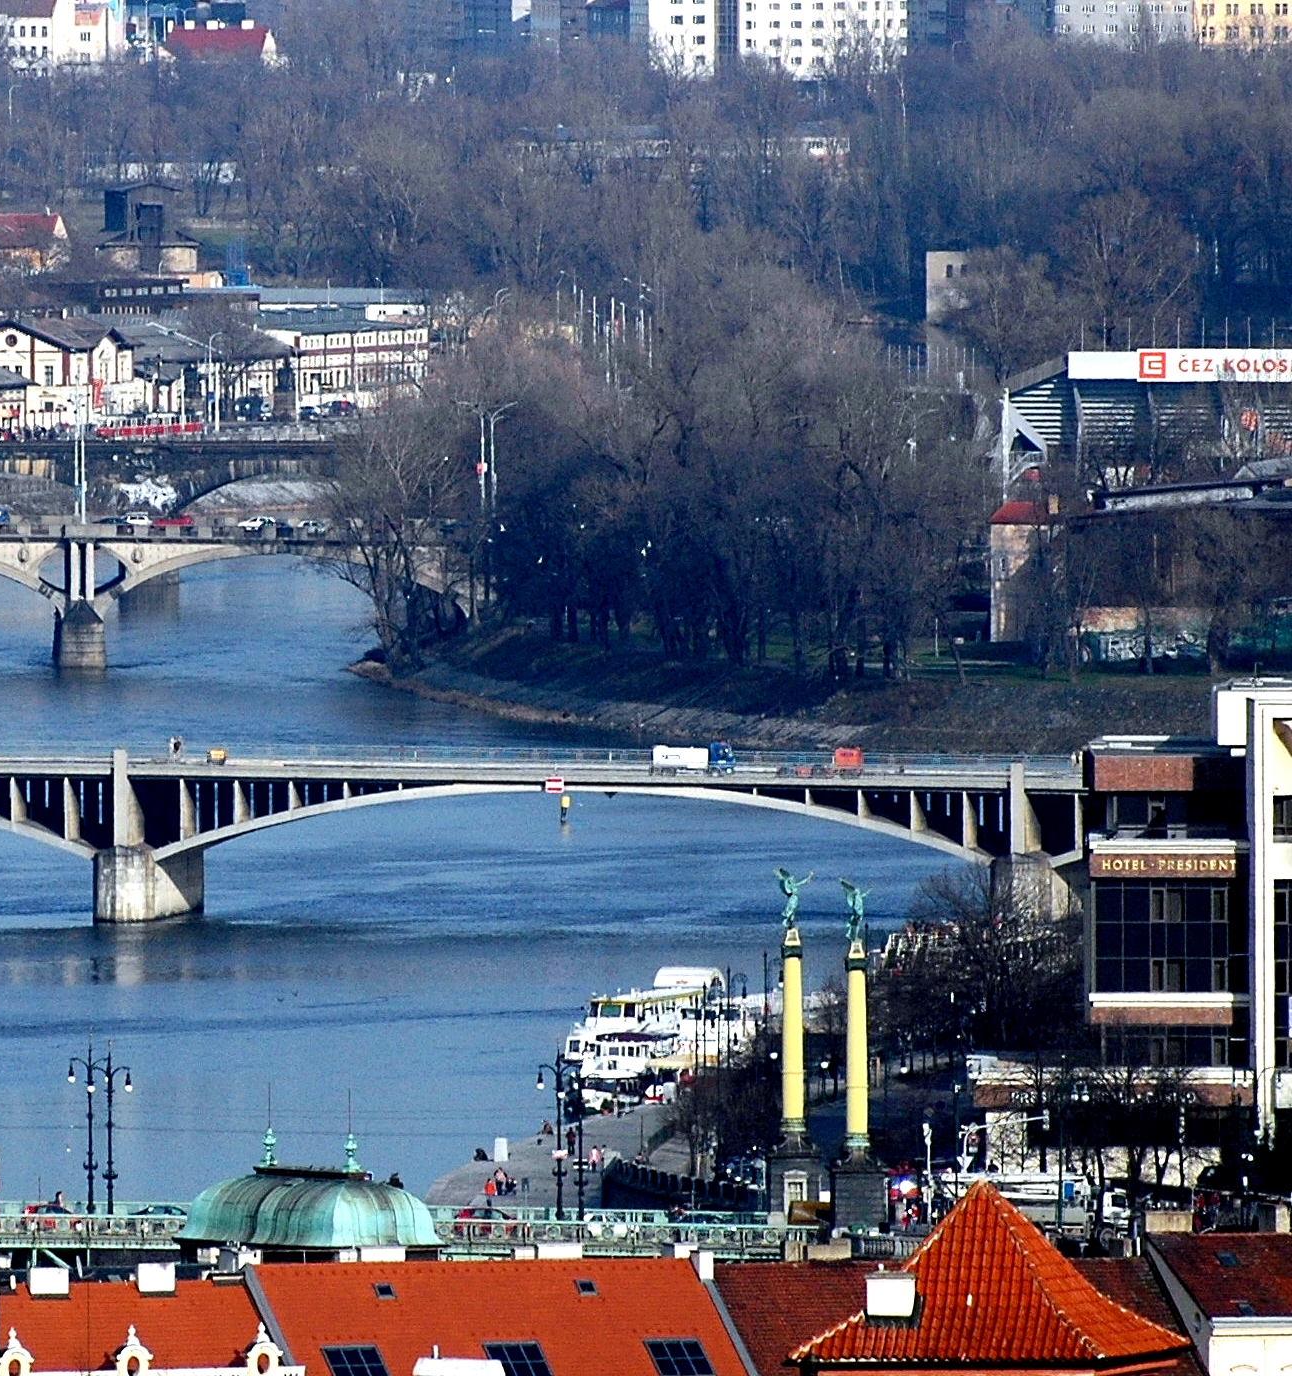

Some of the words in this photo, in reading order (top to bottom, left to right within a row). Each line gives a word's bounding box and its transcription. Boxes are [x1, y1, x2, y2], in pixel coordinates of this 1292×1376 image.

[1178, 354, 1214, 373] ČEZ
[1223, 358, 1292, 373] KOLOS
[1102, 859, 1148, 871] HOTEL
[1158, 859, 1237, 871] PRESIDENT
